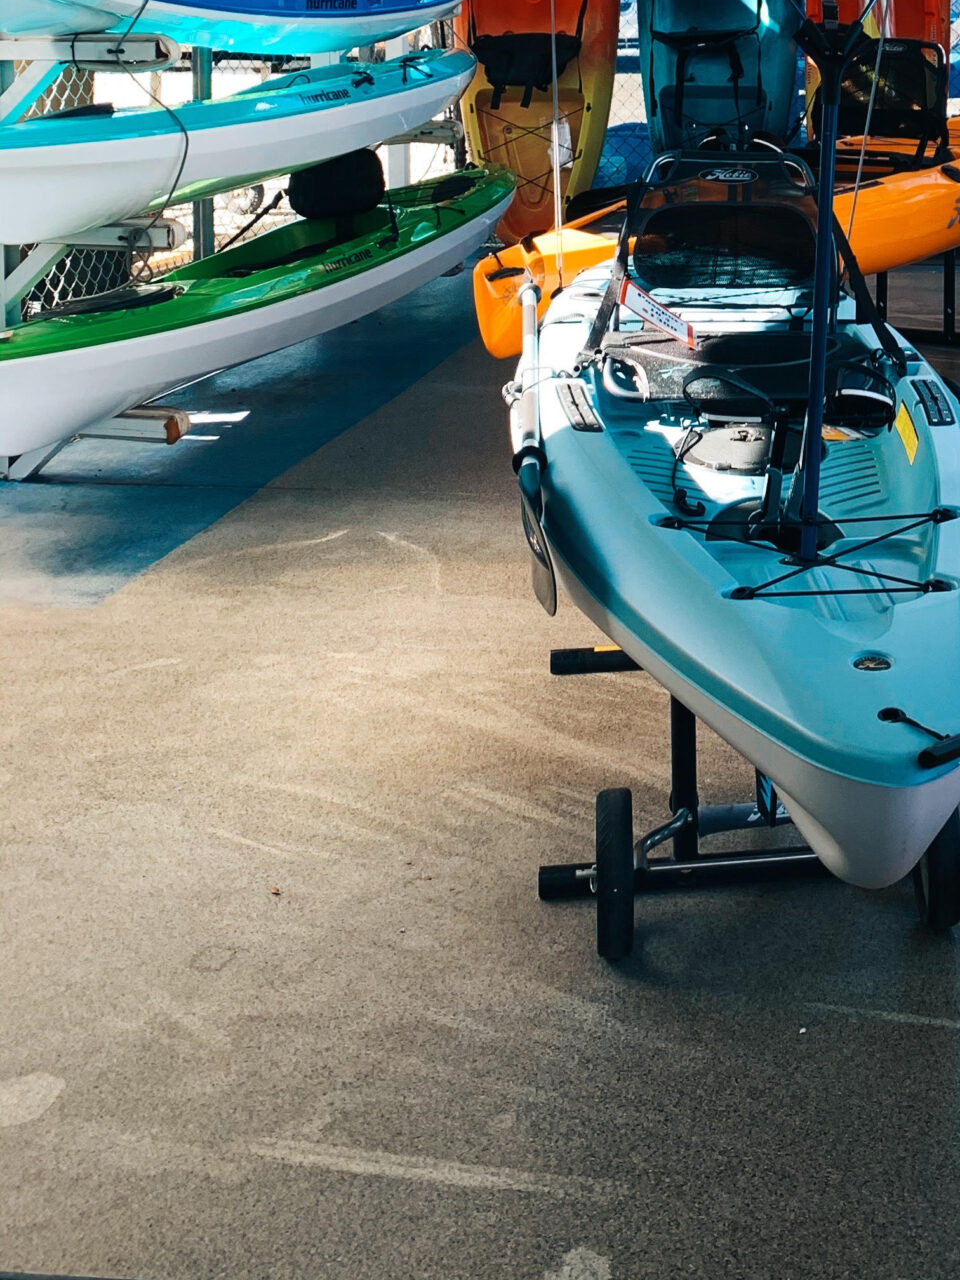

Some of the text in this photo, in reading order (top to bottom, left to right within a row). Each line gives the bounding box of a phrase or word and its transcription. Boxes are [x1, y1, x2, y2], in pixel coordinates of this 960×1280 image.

[299, 88, 351, 106] hurricane
[705, 169, 752, 180] Hobie
[322, 247, 374, 274] hurricane
